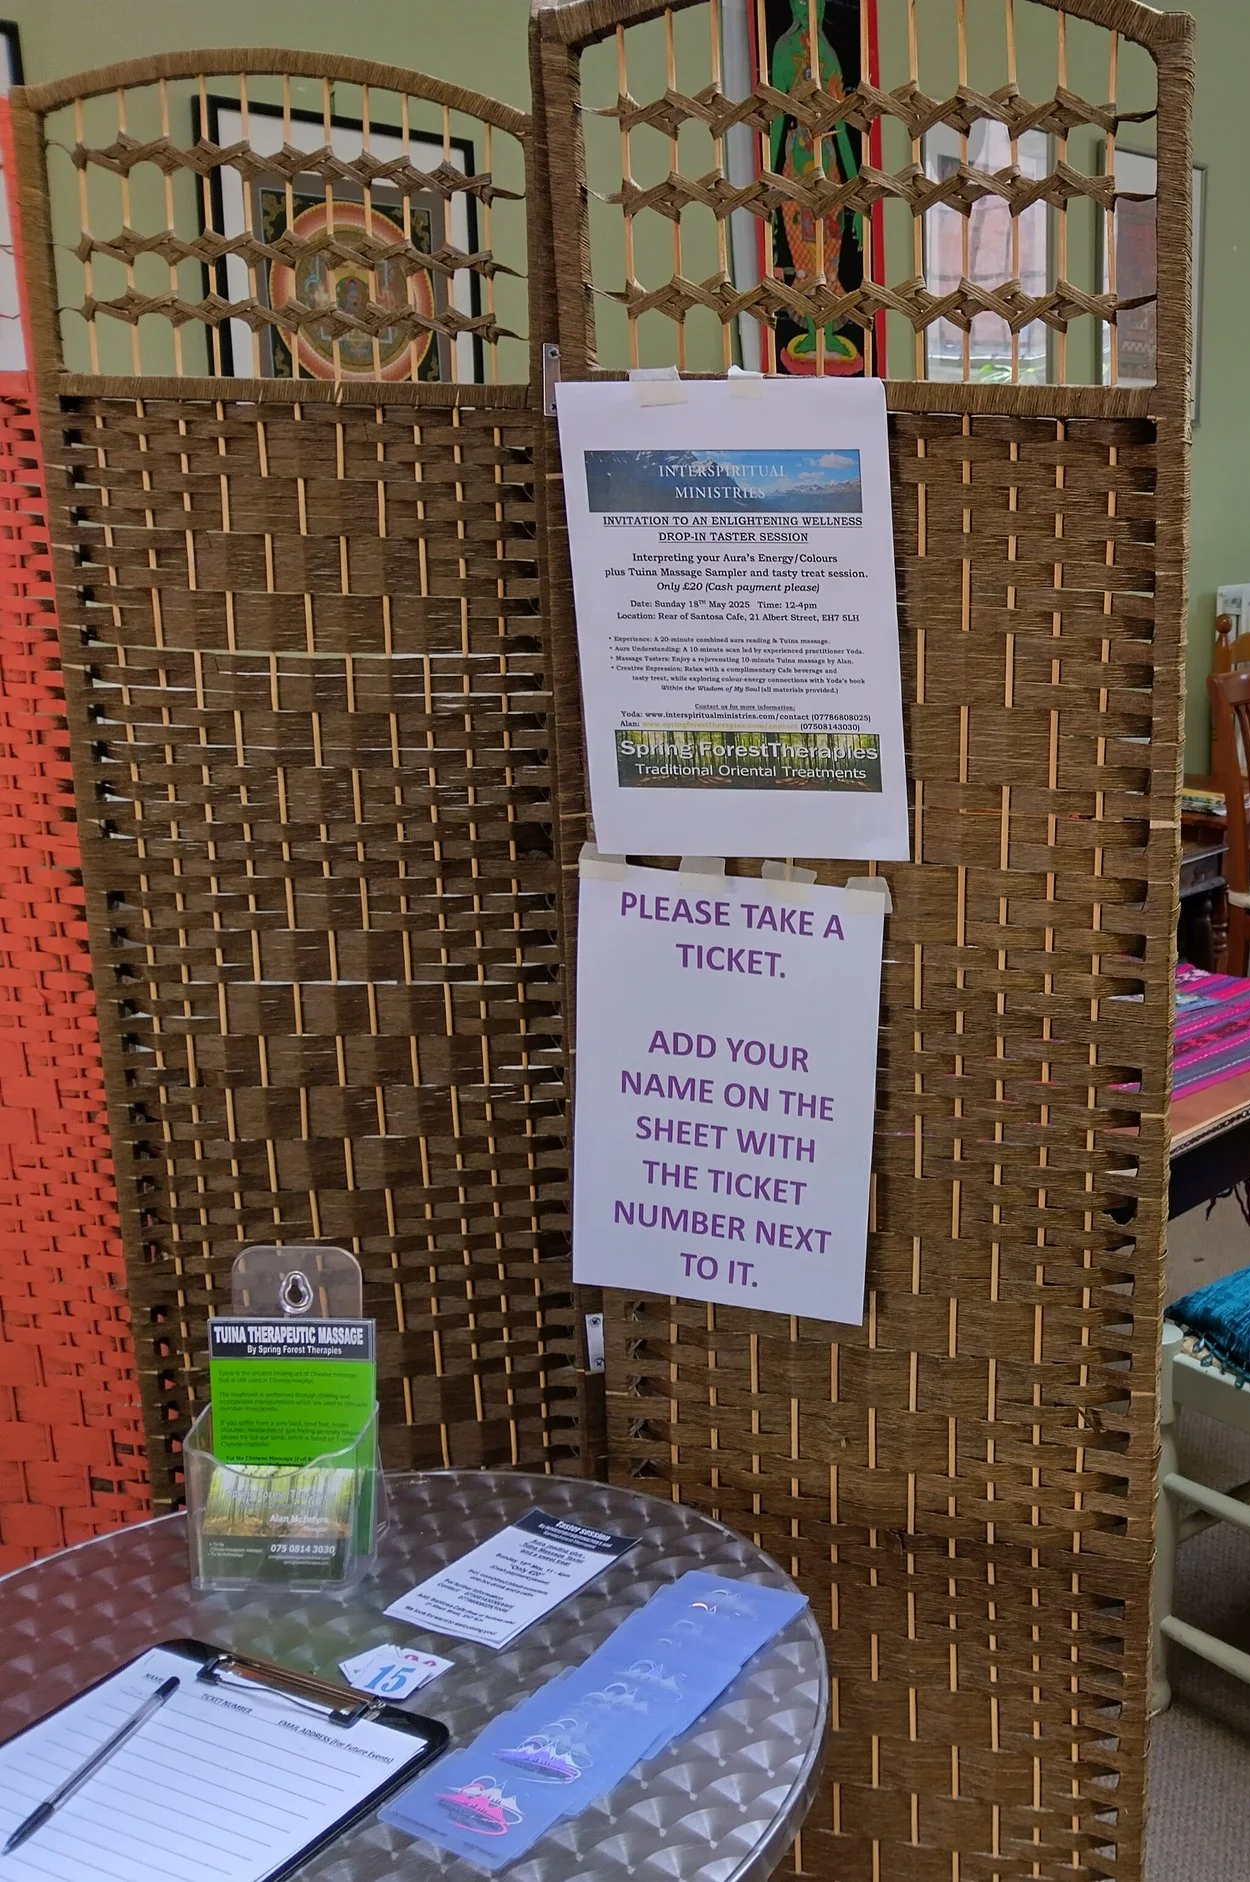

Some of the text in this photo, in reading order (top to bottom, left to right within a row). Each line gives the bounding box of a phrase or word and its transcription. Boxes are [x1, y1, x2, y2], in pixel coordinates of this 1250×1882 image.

[659, 465, 787, 478] INTERSPIRITUAL
[675, 486, 766, 499] MINISTRIES
[603, 516, 862, 525] INVITATION TO AN ENLIGHTENING WELLNESS
[658, 532, 807, 542] DROP-IN TASTER SESSION
[632, 553, 837, 564] Interpreting your Aura's Energy/Colours
[605, 567, 867, 579] plus Tuina Massage Sampler and tasty treat session.
[656, 582, 819, 593] Only £20 (Cash payment please)
[654, 600, 685, 609] Sunday
[708, 600, 726, 609] May
[728, 600, 750, 608] 2025
[785, 601, 816, 610] 12-4pm
[690, 612, 723, 620] Santosa
[725, 613, 746, 621] Cafe,
[790, 613, 819, 621] Street,
[726, 666, 775, 674] complimentary
[644, 711, 809, 720] www.interspiritualministries.com/contact
[620, 740, 693, 759] Spring
[635, 763, 867, 779] Traditional Oriental Treatments
[620, 891, 845, 941] PLEASE TAKE A
[675, 943, 786, 979] TICKET.
[648, 1030, 809, 1073] ADD YOUR
[620, 1070, 835, 1122] NAME ON THE
[635, 1115, 816, 1163] SHEET WITH
[642, 1159, 808, 1206] THE TICKET
[613, 1200, 832, 1254] NUMBER NEXT
[680, 1252, 758, 1288] TO IT.
[214, 1326, 363, 1345] TUINA THERAPEUTIC MASSAGE
[247, 1345, 342, 1356] By Spring Forest Therapies
[270, 1514, 288, 1523] Alan
[271, 1544, 287, 1553] 075
[289, 1545, 311, 1553] 0814
[364, 1664, 416, 1692] 15
[200, 1693, 252, 1714] TICKET NUMBER
[278, 1720, 299, 1731] EMAIL
[299, 1728, 331, 1742] ADDRESS
[345, 1743, 368, 1756] Future
